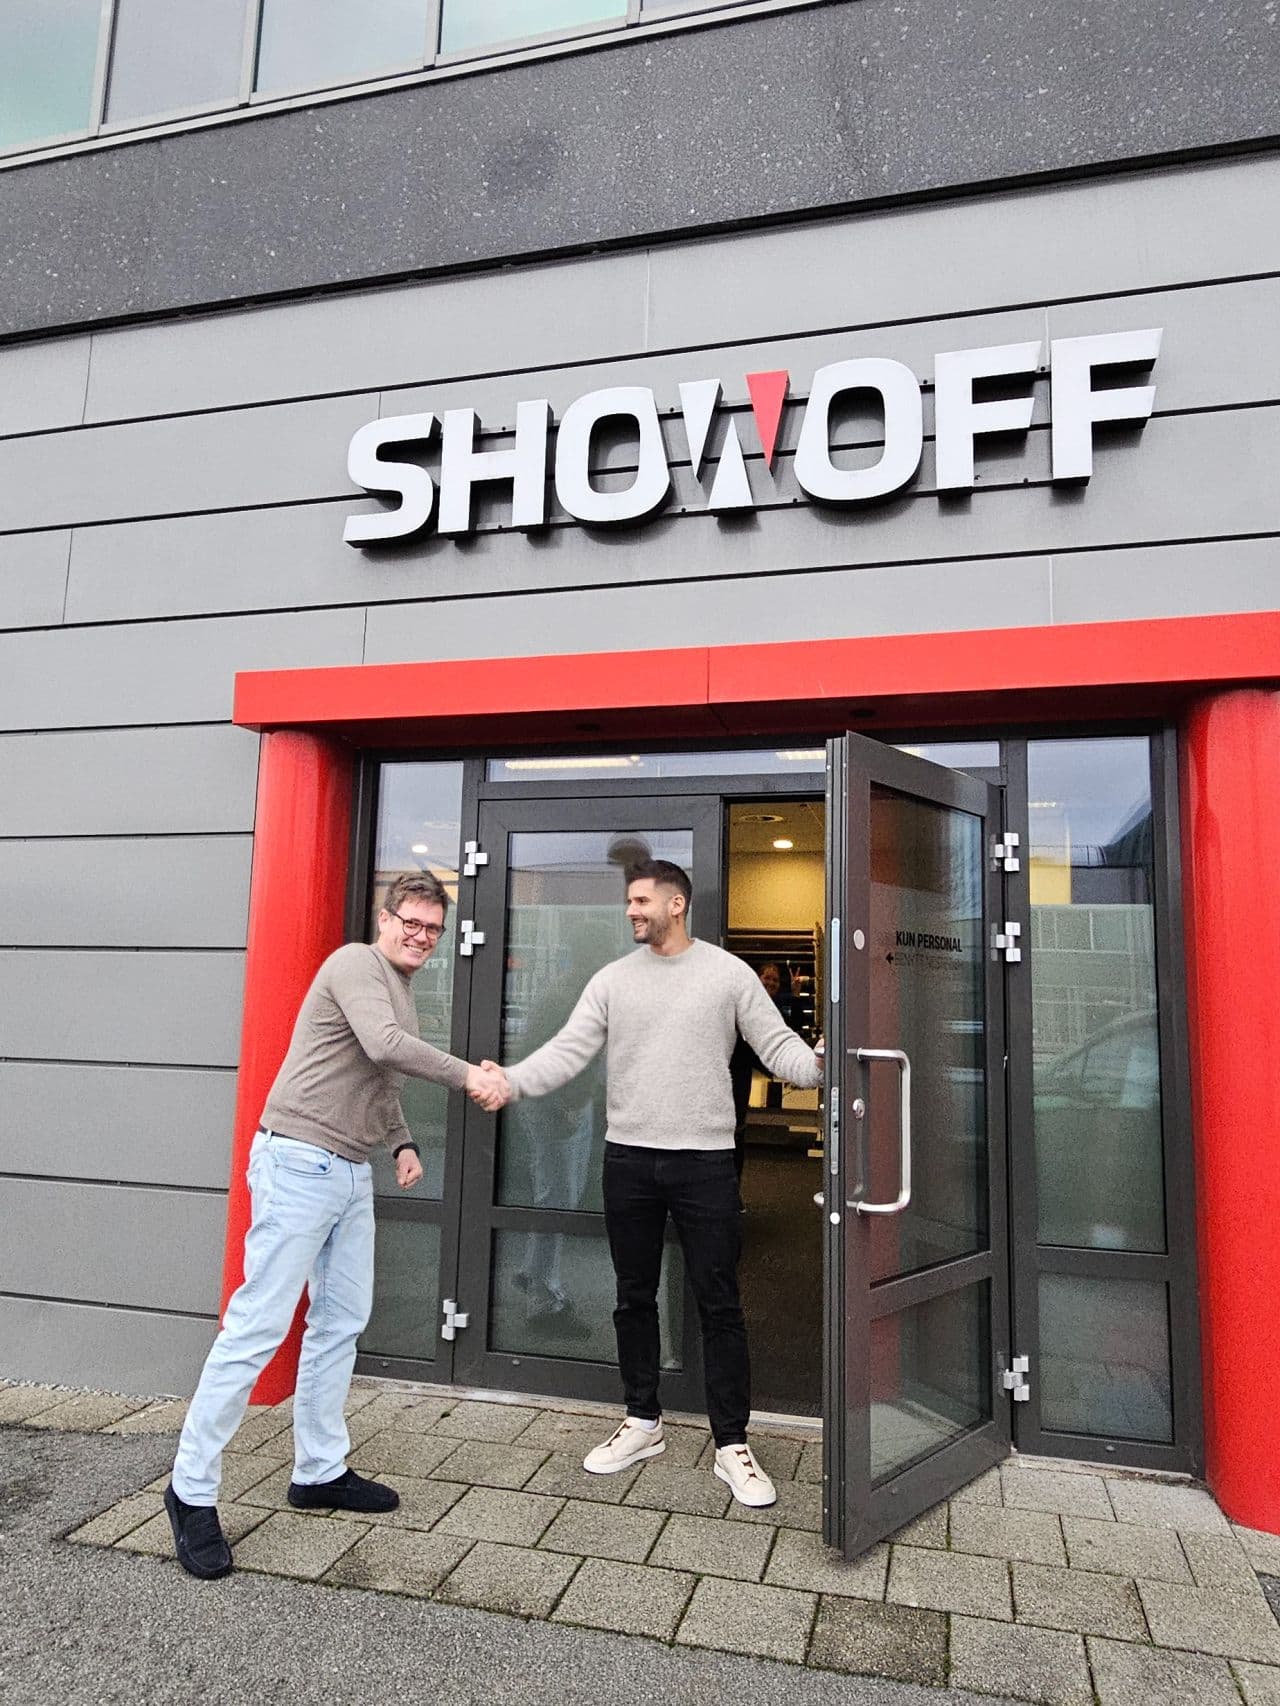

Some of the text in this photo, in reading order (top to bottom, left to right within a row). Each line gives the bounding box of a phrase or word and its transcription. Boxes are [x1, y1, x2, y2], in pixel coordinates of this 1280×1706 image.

[343, 328, 1163, 545] SHOWOFF
[896, 930, 962, 953] KUN PERSONAL
